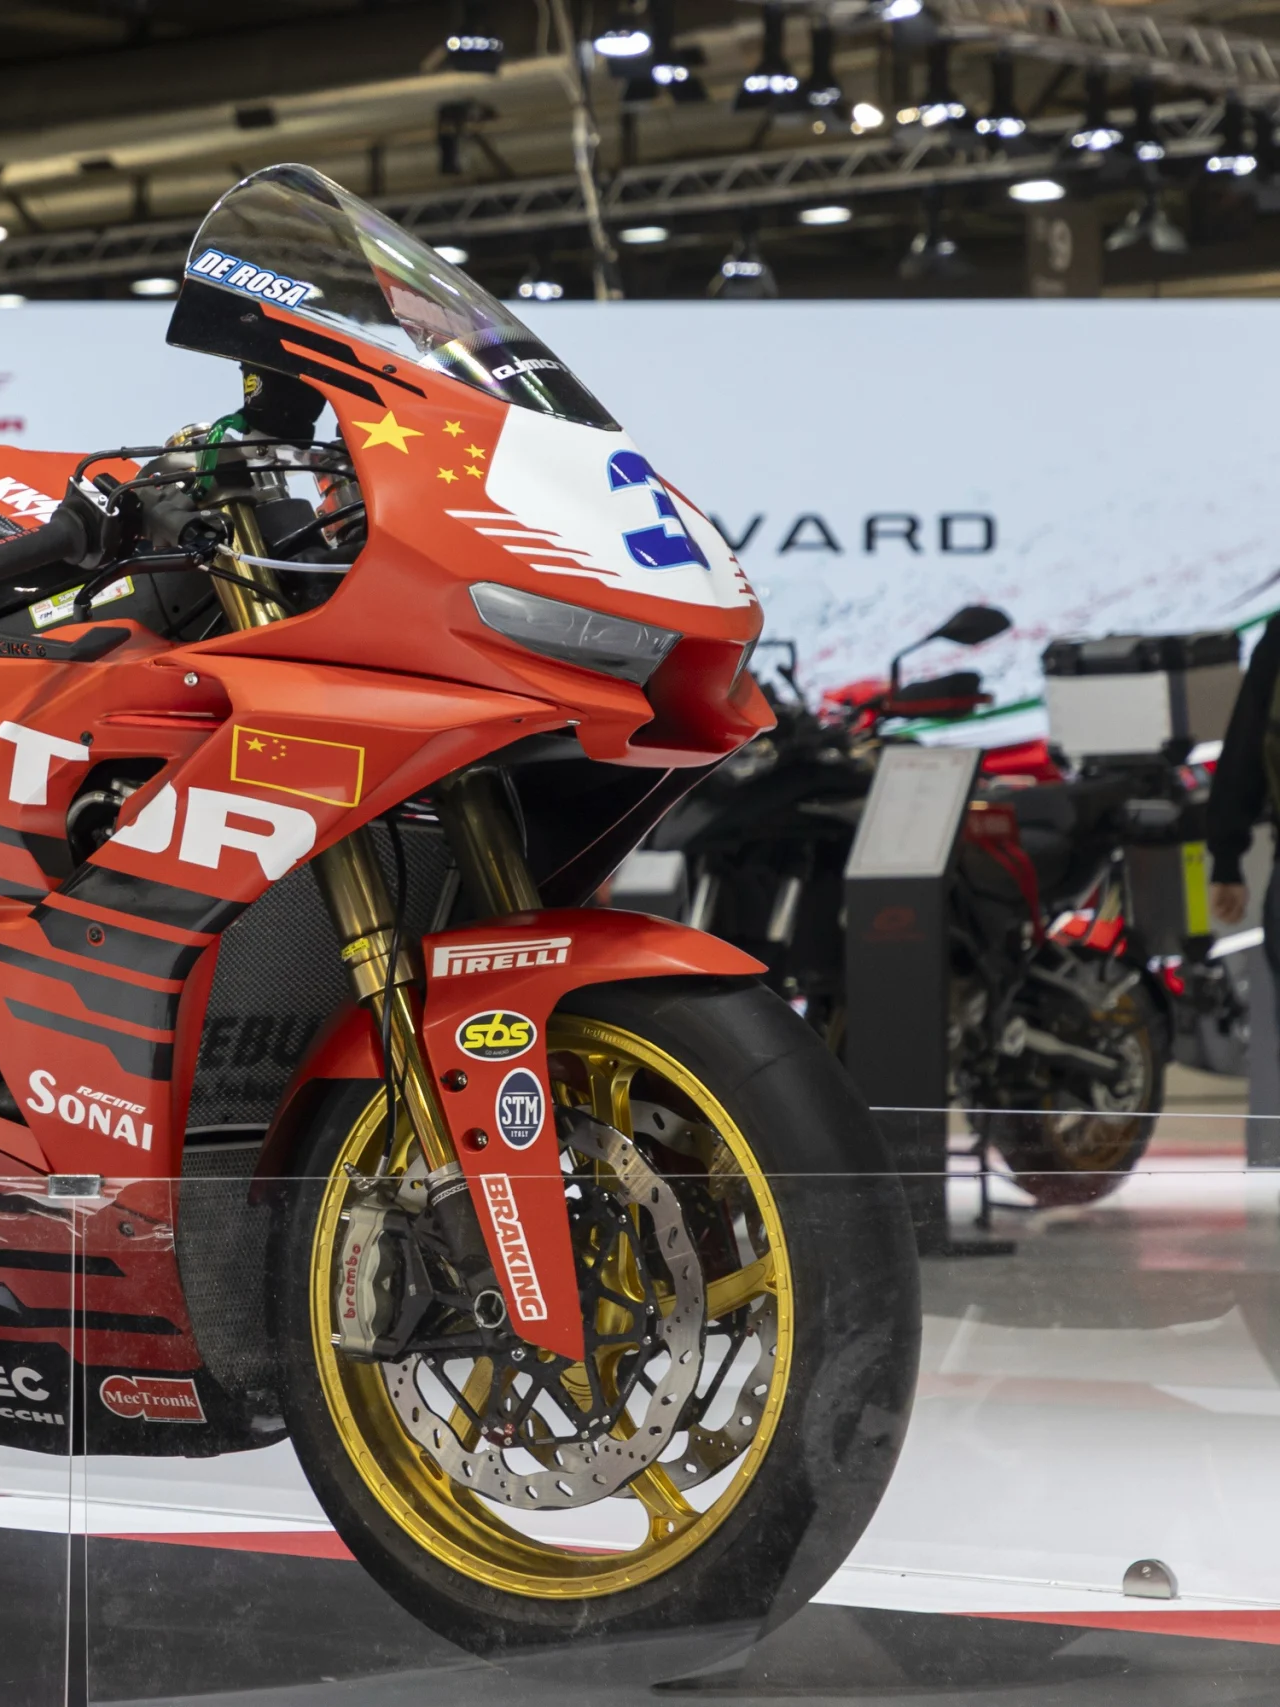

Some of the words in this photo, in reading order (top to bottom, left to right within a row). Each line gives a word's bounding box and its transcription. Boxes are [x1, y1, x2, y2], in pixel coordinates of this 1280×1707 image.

[193, 251, 237, 280] DE
[227, 264, 310, 307] ROSA
[606, 448, 711, 572] 3
[432, 936, 572, 978] PIRELLI
[463, 1012, 530, 1049] sbs
[26, 1069, 154, 1152] SONAI
[76, 1085, 147, 1114] RACING
[501, 1095, 539, 1126] STM
[510, 1130, 529, 1138] ITALY
[481, 1175, 547, 1320] BRAKING
[344, 1243, 361, 1319] brembo
[105, 1389, 198, 1409] MecTronik
